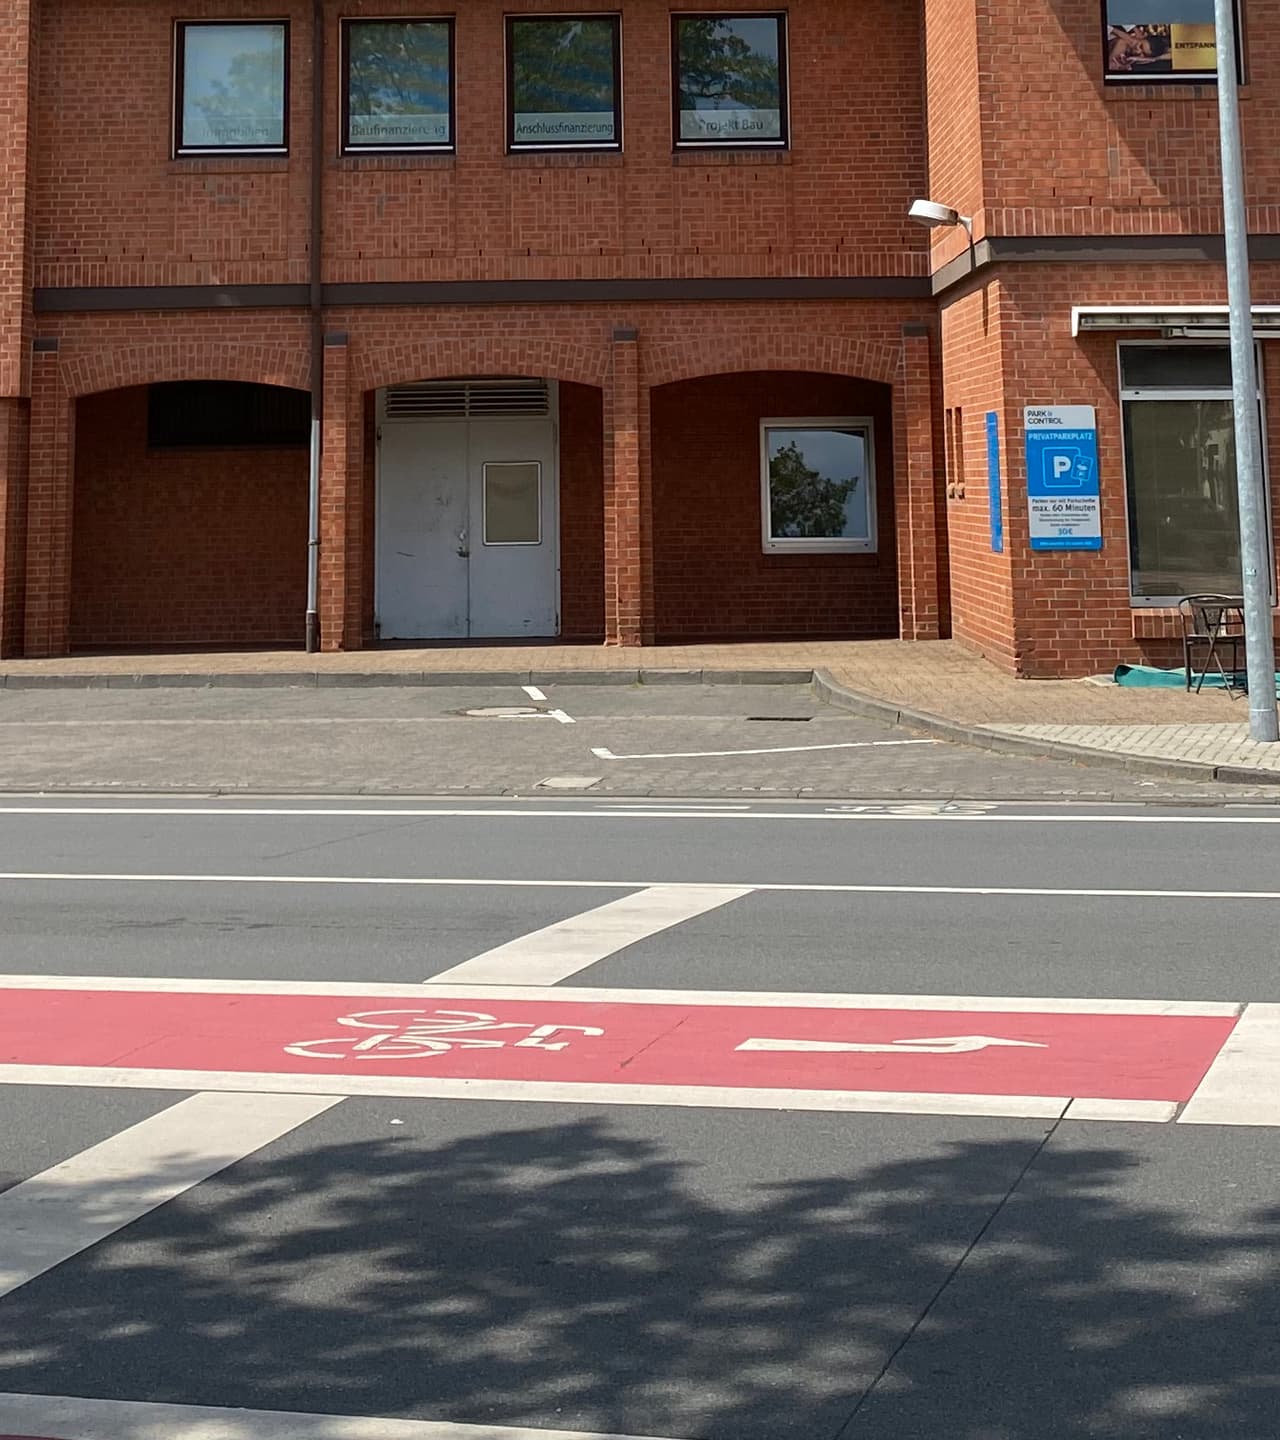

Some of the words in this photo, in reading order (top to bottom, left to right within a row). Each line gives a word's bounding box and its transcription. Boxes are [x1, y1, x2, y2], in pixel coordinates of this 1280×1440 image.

[516, 121, 613, 136] Anschlussfinanzierung
[742, 119, 763, 131] Bau
[1052, 503, 1063, 512] 60
[1065, 504, 1096, 512] Minuten
